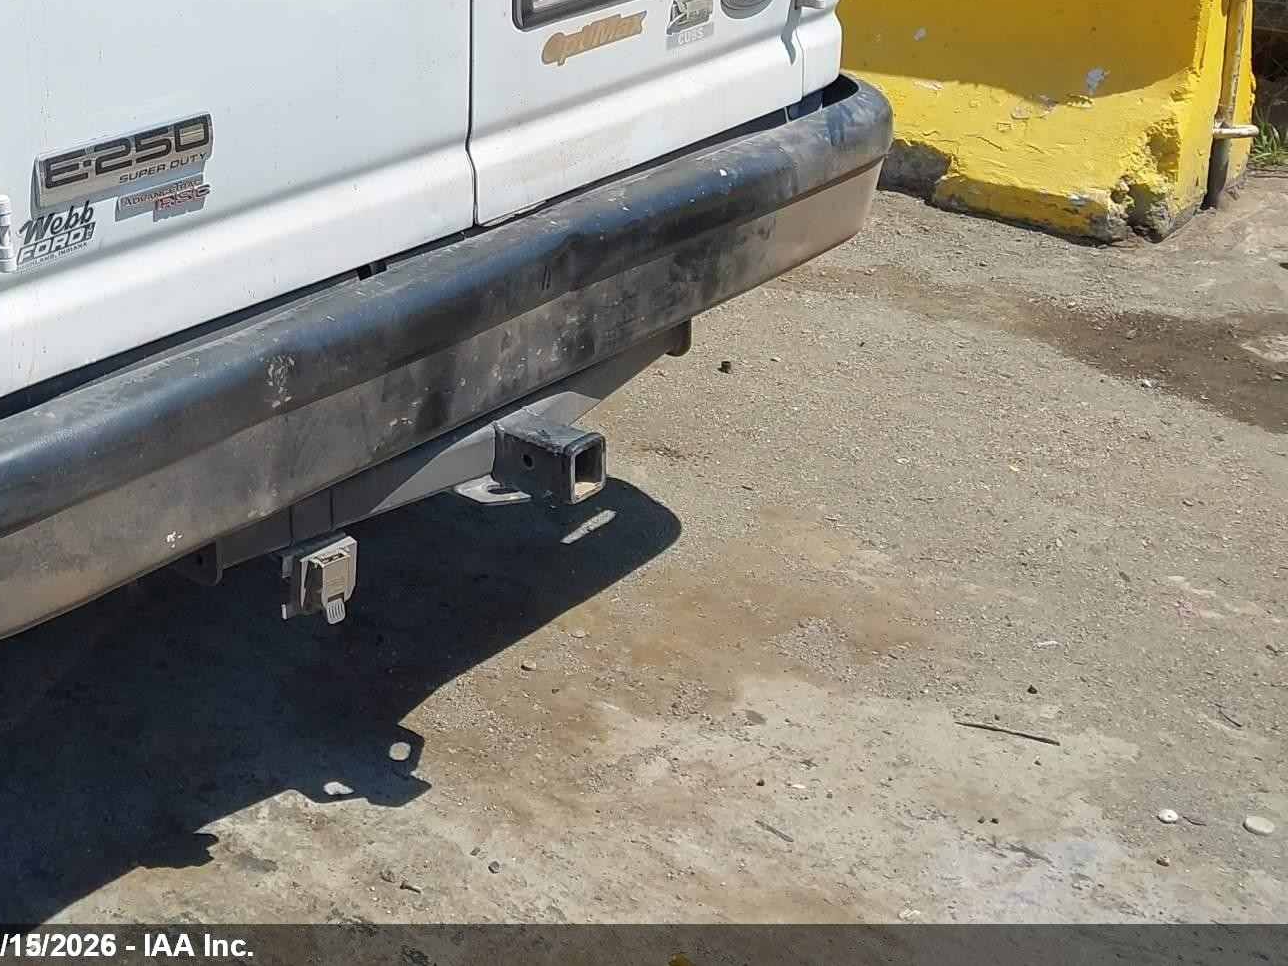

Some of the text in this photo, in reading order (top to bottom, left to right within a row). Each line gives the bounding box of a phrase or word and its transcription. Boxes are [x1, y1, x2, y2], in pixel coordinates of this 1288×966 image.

[45, 114, 210, 190] E-250
[119, 152, 207, 184] SUPER DUTY
[19, 200, 94, 245] Webb
[18, 227, 87, 266] FORD
[58, 242, 88, 257] INDIANA
